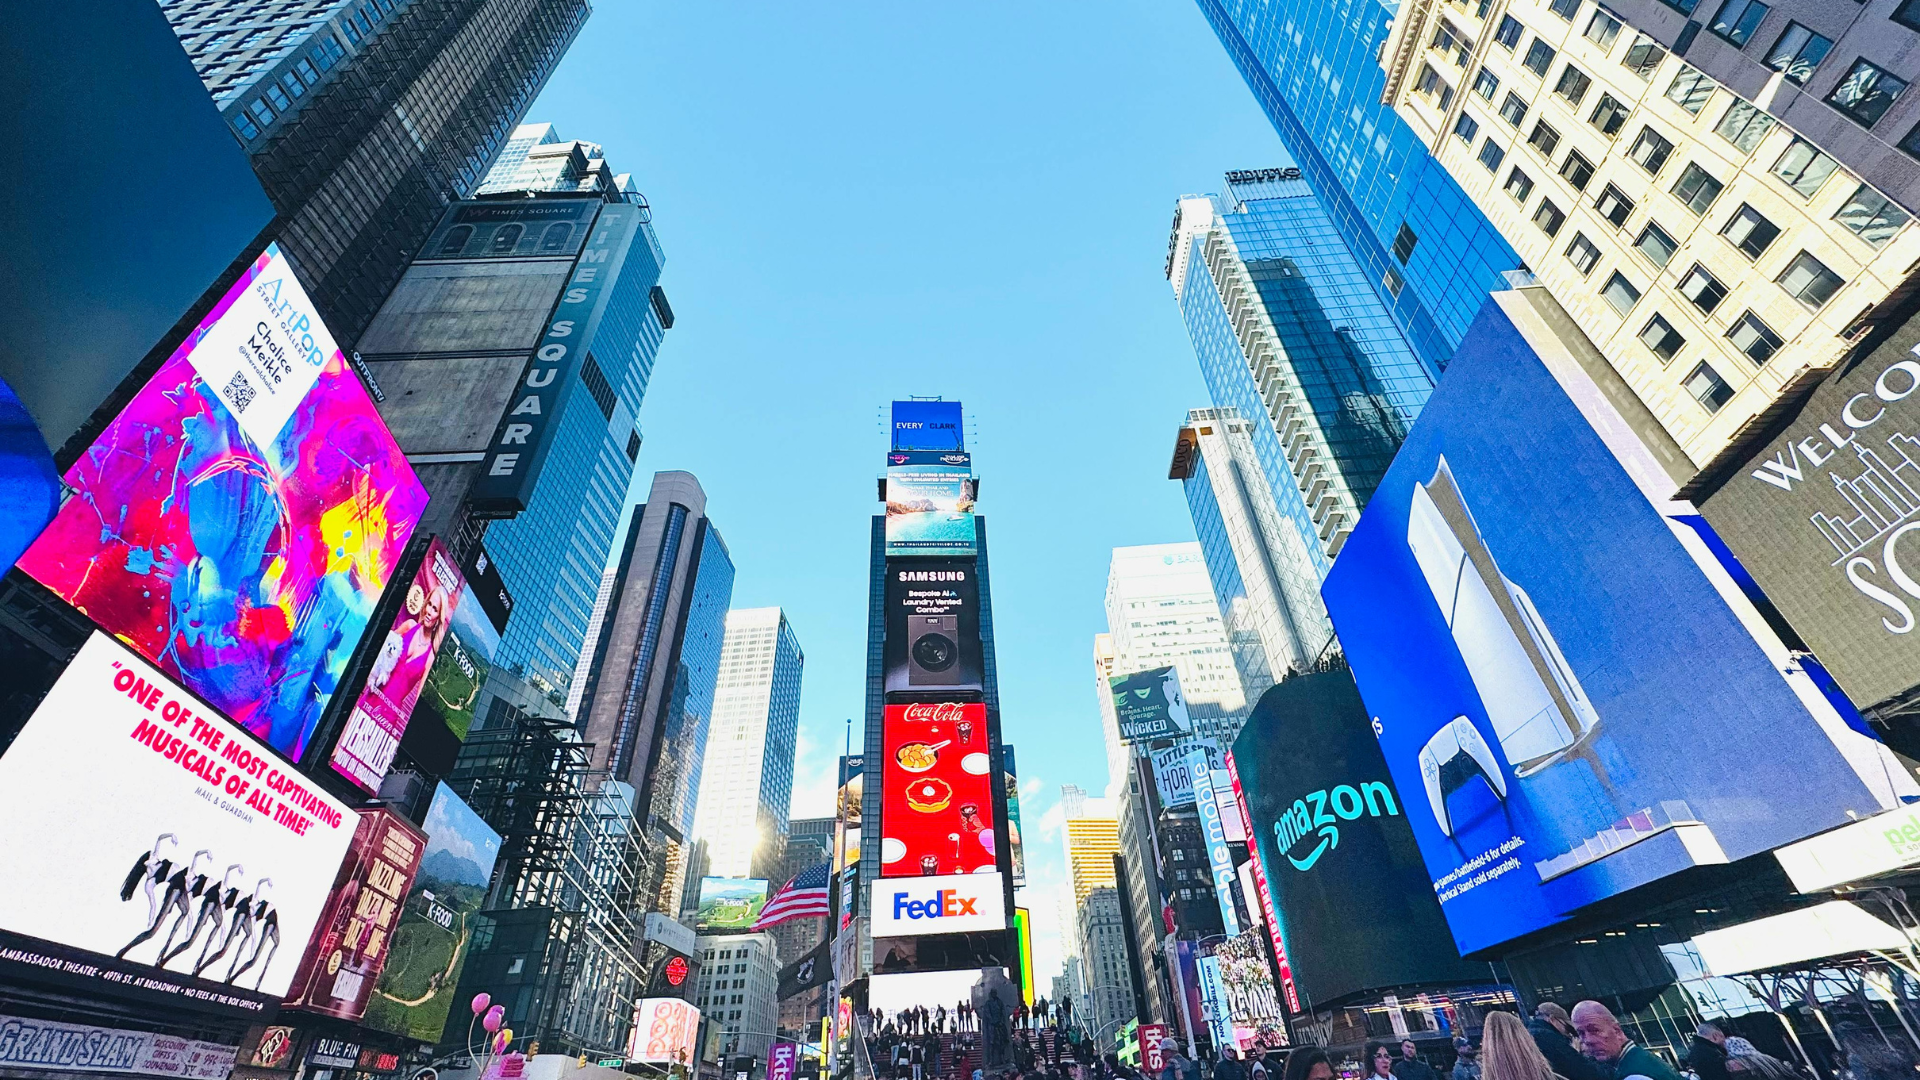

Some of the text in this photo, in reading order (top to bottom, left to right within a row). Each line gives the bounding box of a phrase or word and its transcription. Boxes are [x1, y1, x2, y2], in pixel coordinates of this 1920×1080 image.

[563, 214, 622, 303] TIMES
[256, 286, 307, 360] STREET GALLERY
[262, 278, 324, 366] ArtPop
[238, 345, 276, 395] @therealchalice
[248, 334, 282, 384] Meikle
[256, 321, 292, 374] Chalice
[488, 320, 575, 476] SQUARE
[1751, 341, 1920, 491] WELCO
[929, 422, 957, 430] CLARK
[898, 571, 965, 582] SAMSUNG
[908, 590, 941, 598] Bespoke
[453, 647, 476, 679] K-FOOD
[903, 702, 966, 722] Coca-Cola
[161, 700, 193, 729] OF
[188, 716, 225, 752] THE
[220, 739, 270, 780] MOST
[265, 769, 343, 829] CAPTIVATING
[340, 706, 400, 778] VERSAILLES
[1158, 745, 1189, 769] LITTLE
[130, 718, 227, 787] MUSICALS
[224, 774, 250, 800] OF
[244, 788, 272, 817] ALL
[194, 786, 254, 824] MAIL & GUARDIAN
[1194, 762, 1225, 843] mobile
[1274, 781, 1399, 856] amazon
[1489, 848, 1501, 860] for
[1500, 835, 1526, 855] details.
[1457, 877, 1475, 894] Stand
[1473, 871, 1488, 887] sold
[1485, 857, 1522, 880] separately.
[426, 901, 453, 928] K-FOOD
[893, 888, 978, 920] FedEx
[1260, 884, 1288, 970] CHOCOLATE
[1, 948, 257, 1010] AMBASSADOR THEATRE 49TH ST. AT BROADWAY NO FEES AT THE BOX OFFICE
[317, 1038, 361, 1058] BLUE FIN
[1145, 1028, 1163, 1070] tkts
